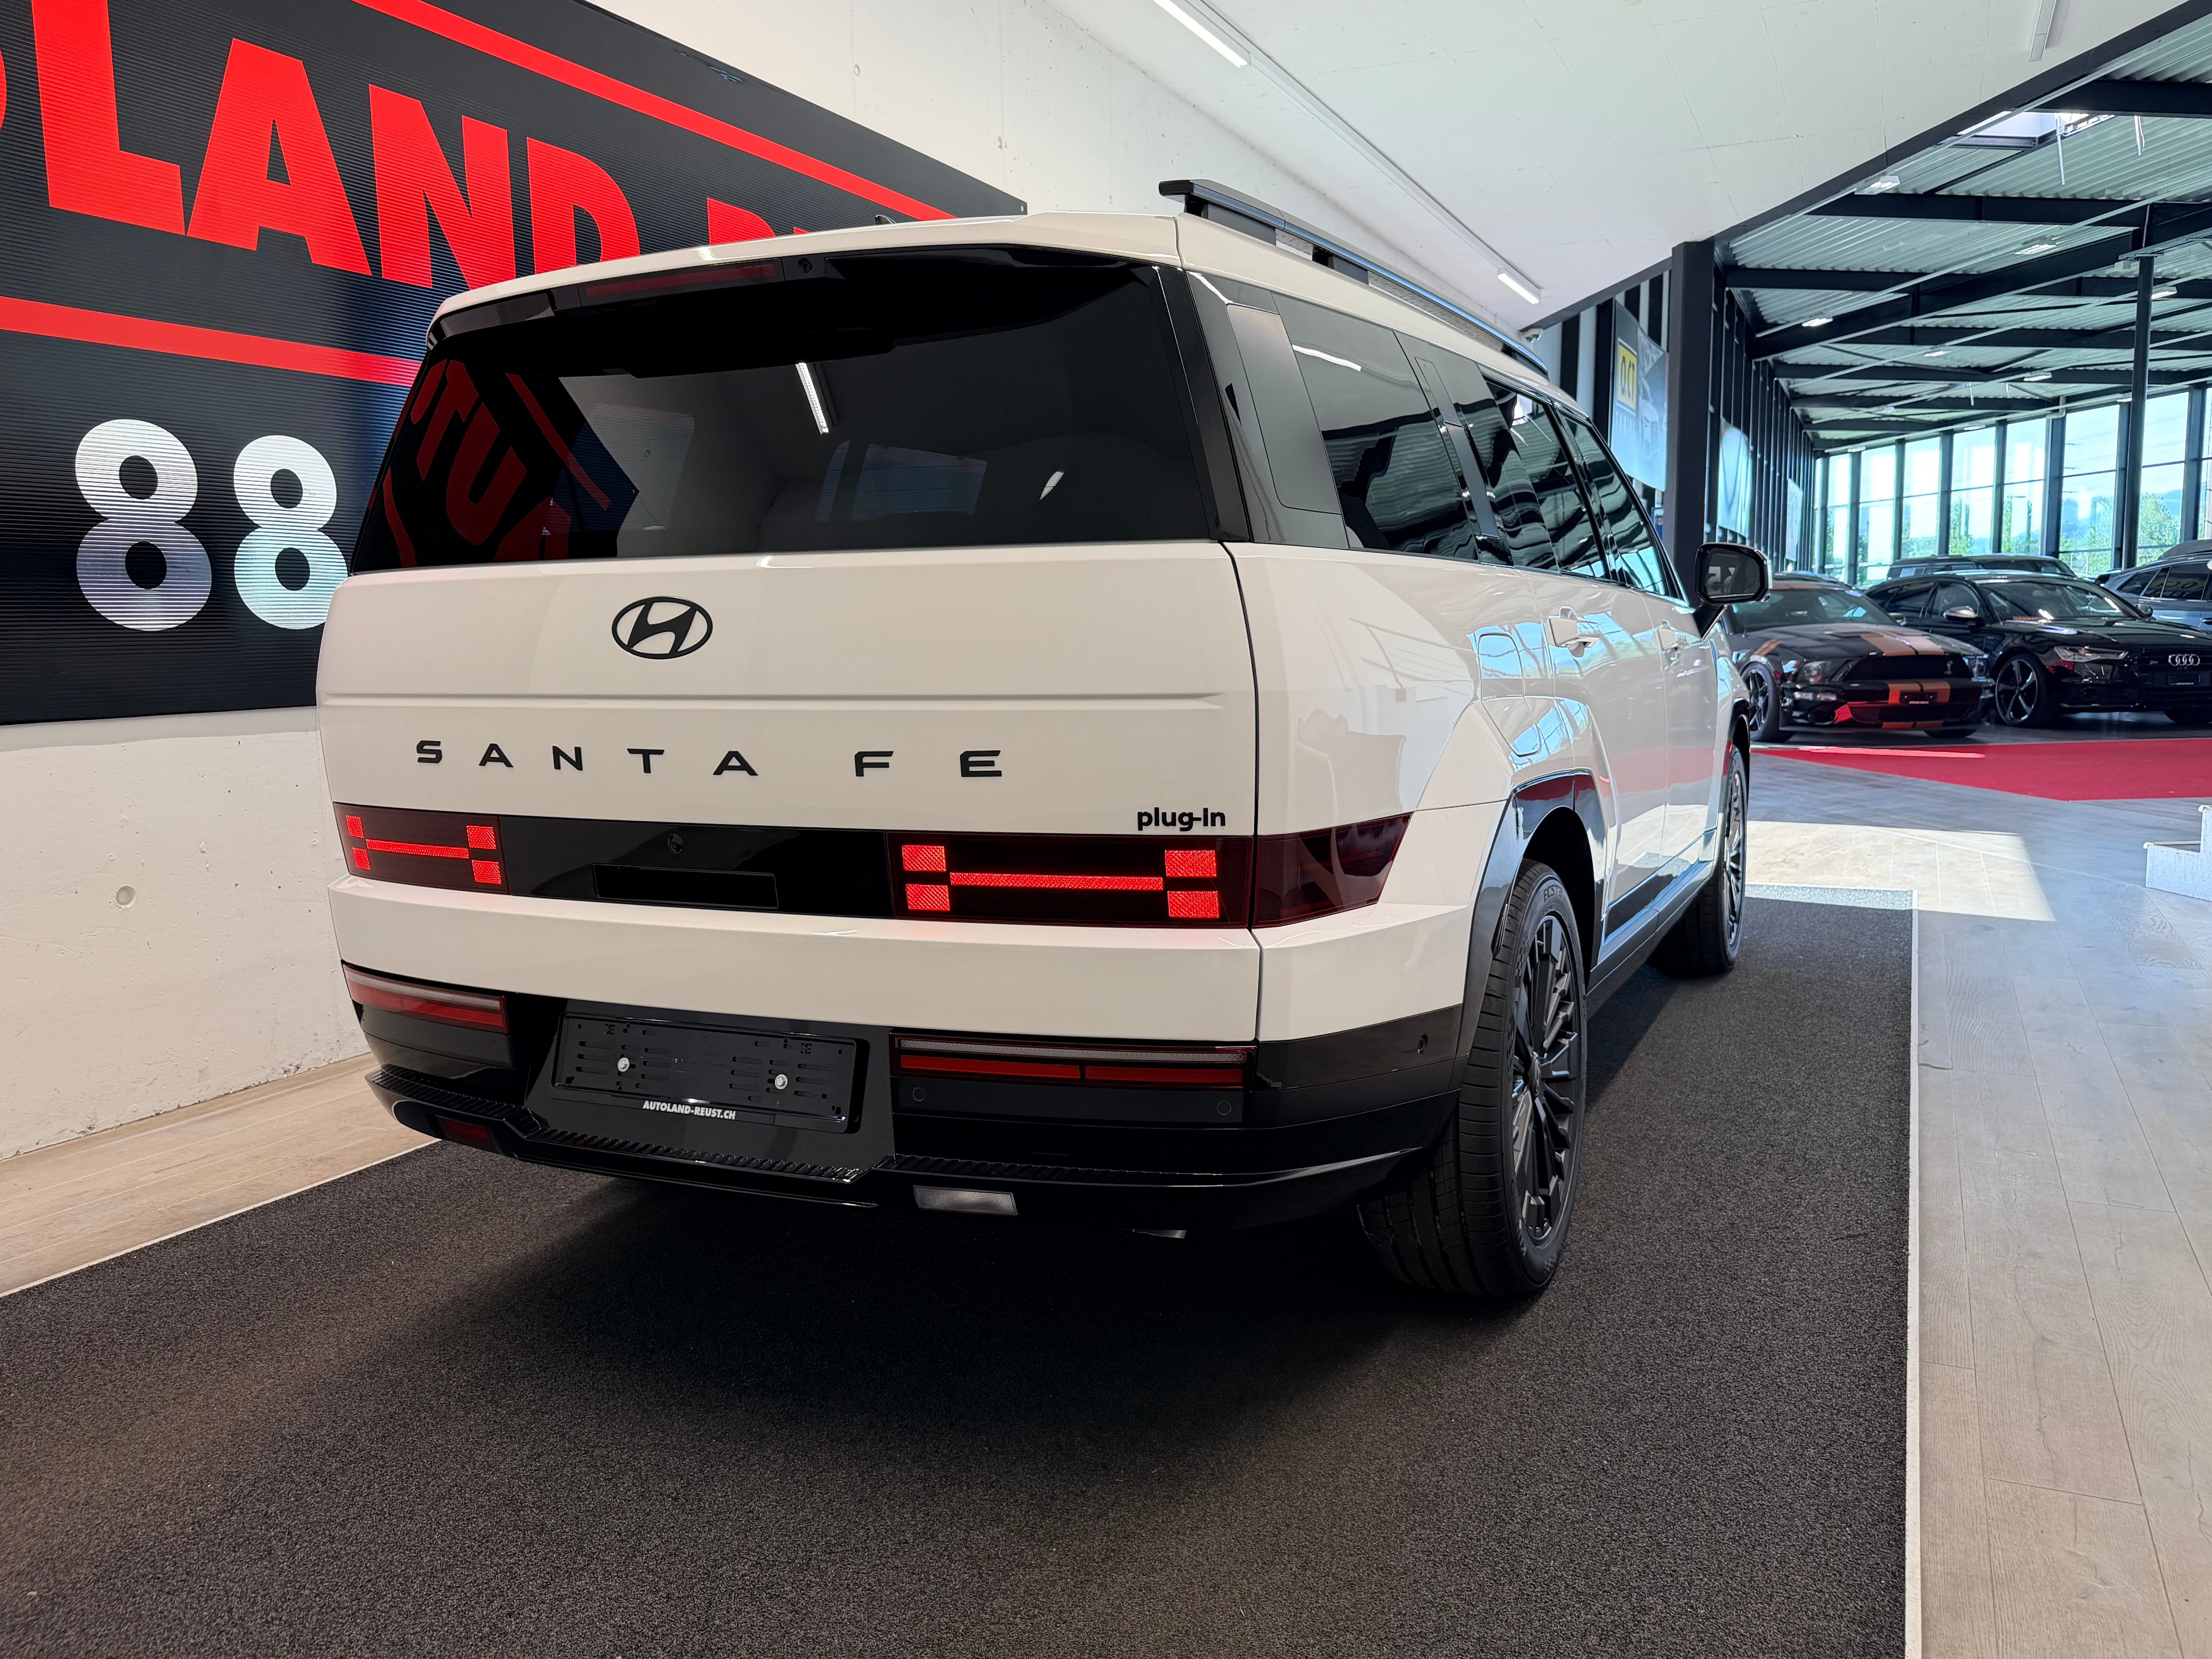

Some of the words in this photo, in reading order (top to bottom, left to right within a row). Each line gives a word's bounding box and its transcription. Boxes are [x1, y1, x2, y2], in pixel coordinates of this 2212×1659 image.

[0, 0, 641, 290] LAND
[416, 740, 758, 776] SANTA
[854, 750, 1002, 777] FE
[1137, 807, 1226, 831] plug-in
[642, 1100, 736, 1120] AUTOLAND-REUST.CH
